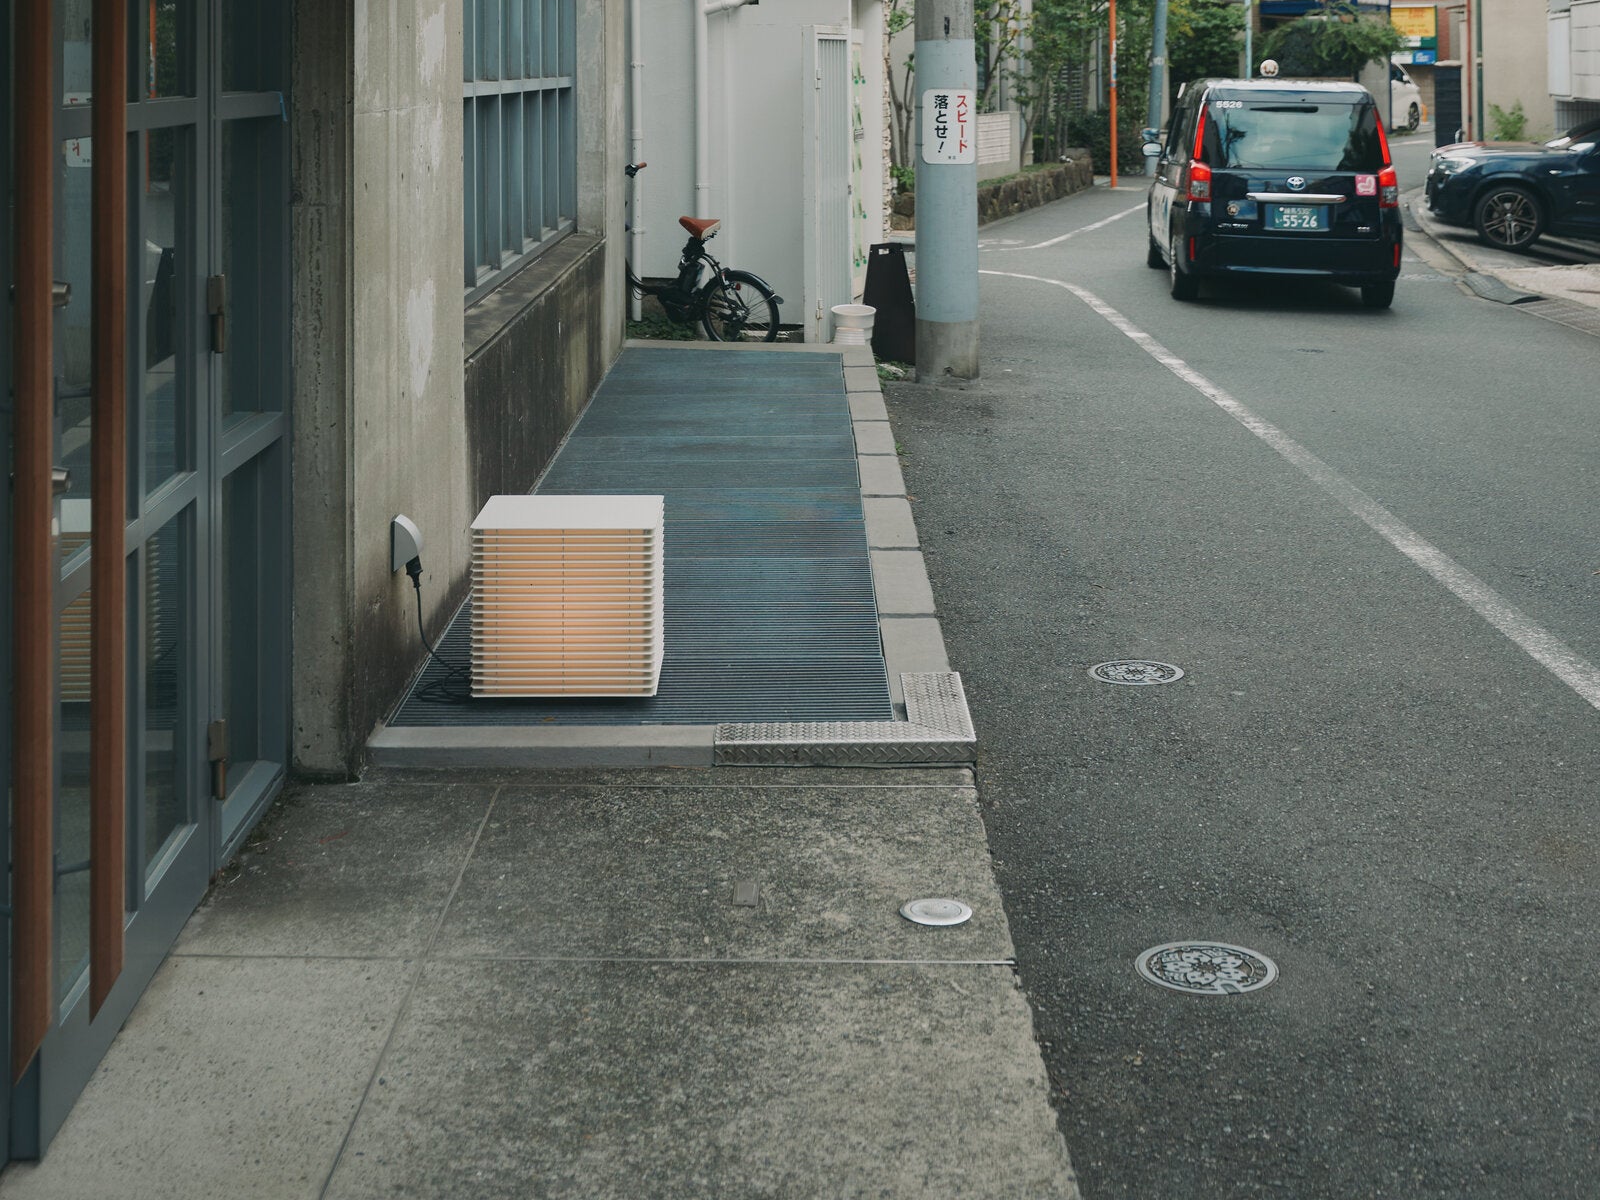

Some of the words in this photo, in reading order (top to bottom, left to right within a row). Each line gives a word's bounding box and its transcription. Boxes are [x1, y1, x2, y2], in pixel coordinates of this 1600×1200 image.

[1216, 100, 1243, 109] 5526
[934, 95, 949, 154] 落とせ!
[956, 95, 968, 154] スピード
[1283, 214, 1318, 228] 55-26
